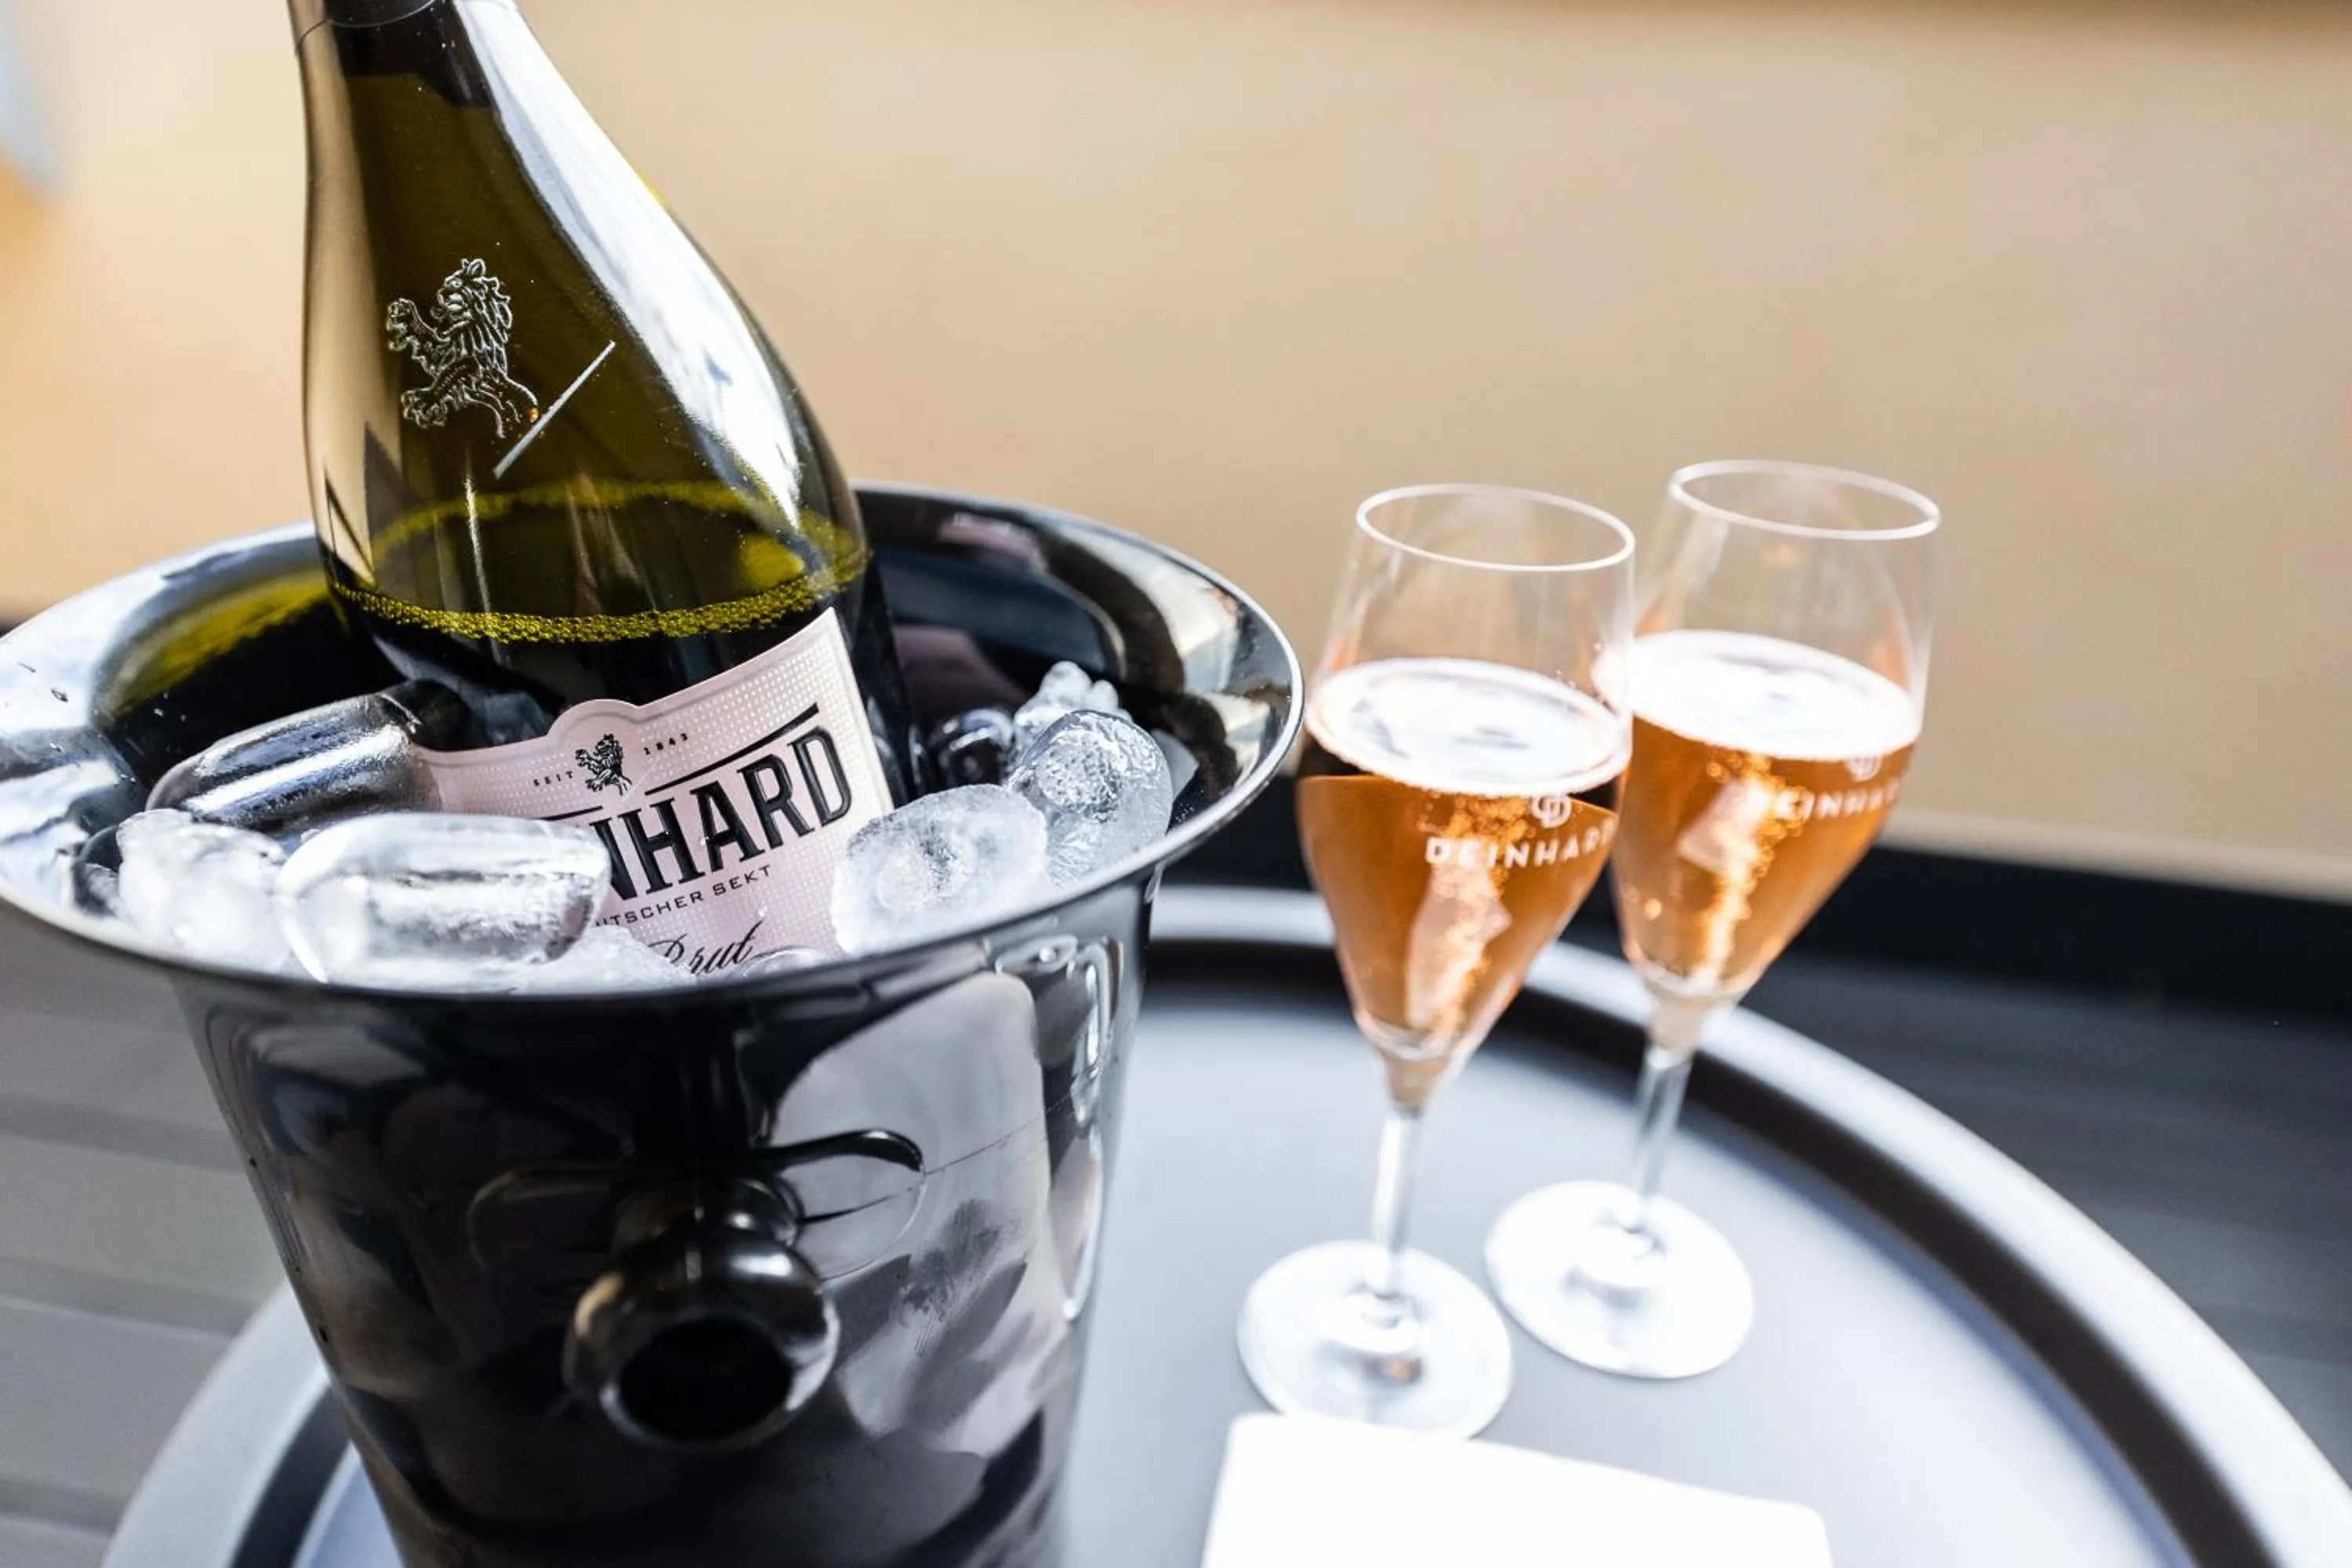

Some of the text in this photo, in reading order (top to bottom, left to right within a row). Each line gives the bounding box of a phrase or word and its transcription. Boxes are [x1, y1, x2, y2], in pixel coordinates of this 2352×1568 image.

[533, 732, 688, 787] SEIT 1843
[589, 728, 852, 901] NHARD
[711, 864, 771, 897] SEKT
